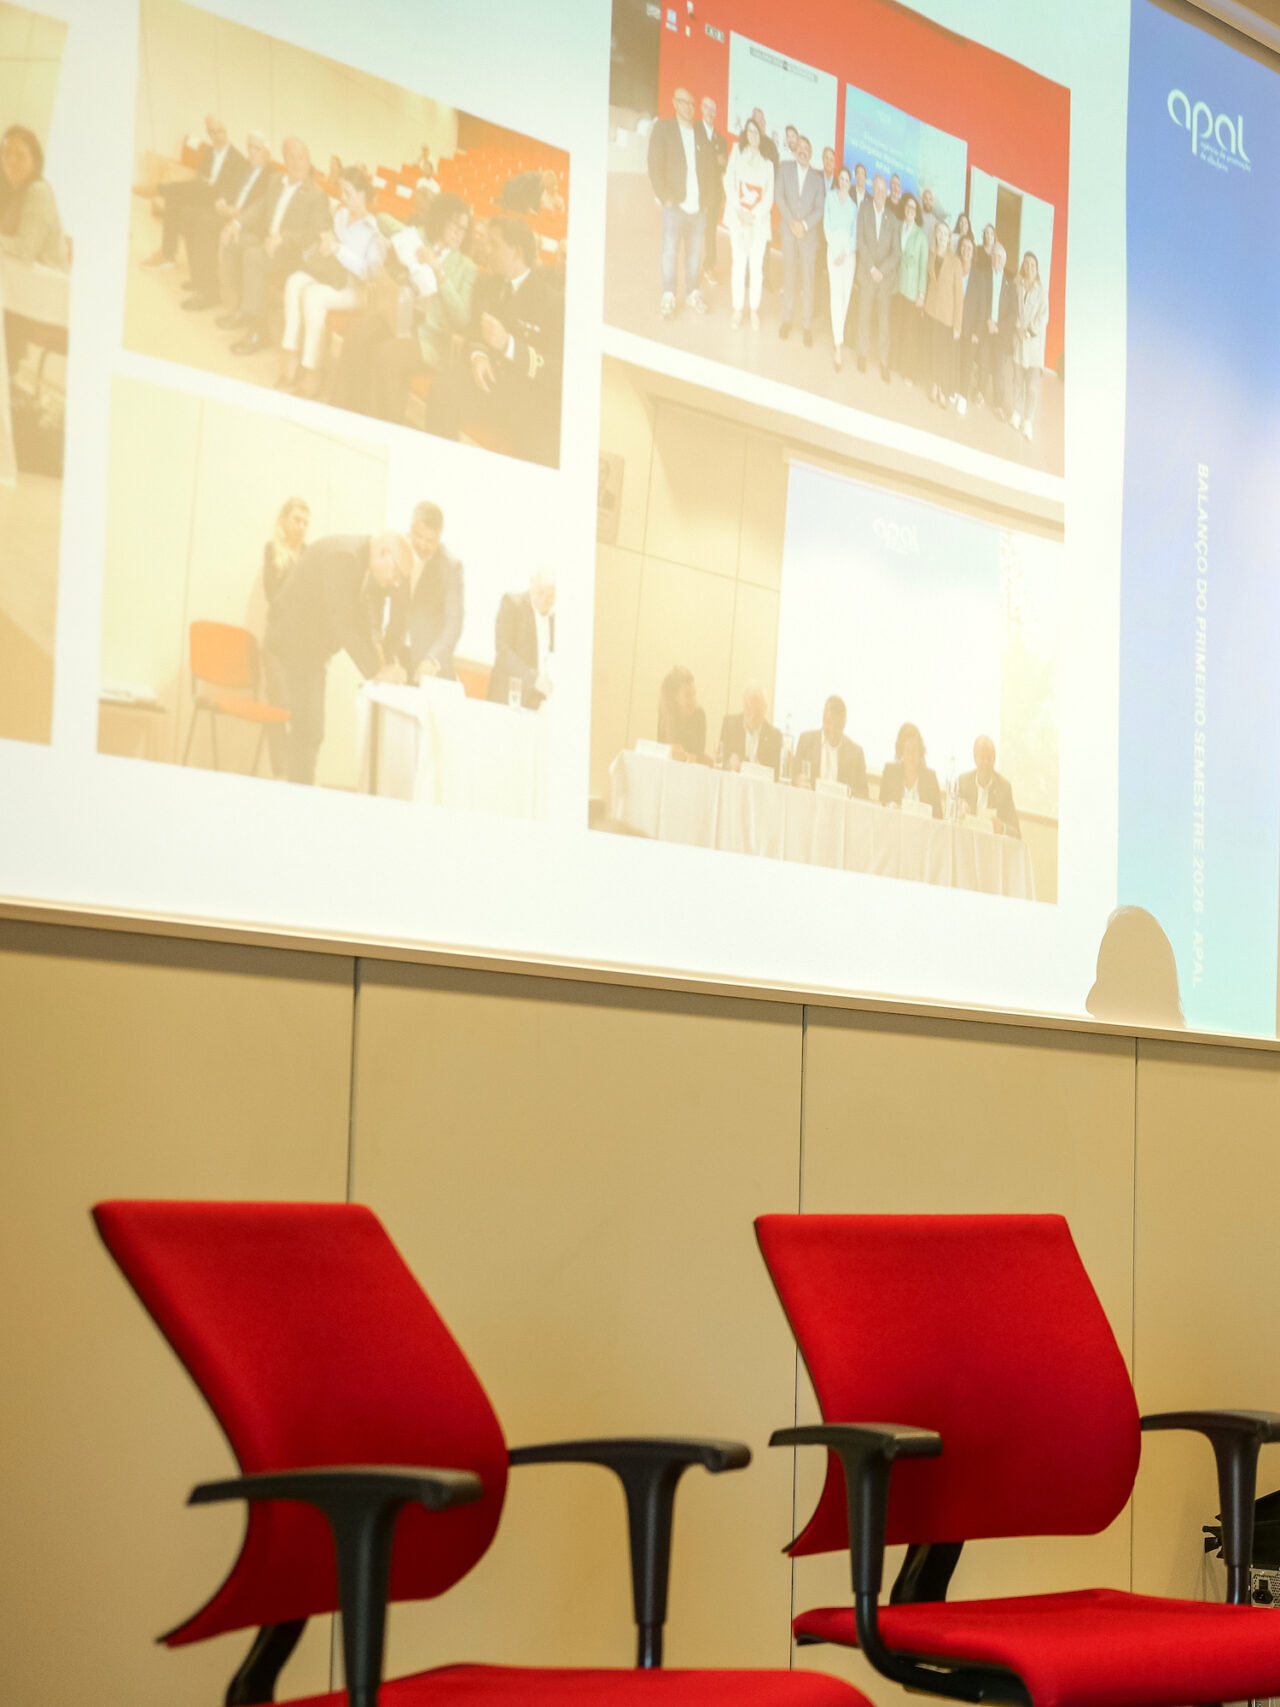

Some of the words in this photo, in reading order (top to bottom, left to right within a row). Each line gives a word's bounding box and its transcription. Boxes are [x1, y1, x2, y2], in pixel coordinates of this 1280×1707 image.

[1167, 88, 1251, 164] apal
[1195, 463, 1209, 575] BALANÇO
[1195, 577, 1208, 612] DO
[1193, 616, 1208, 727] PRIMEIRO
[1192, 729, 1207, 851] SEMESTRE
[1192, 930, 1206, 991] APAL
